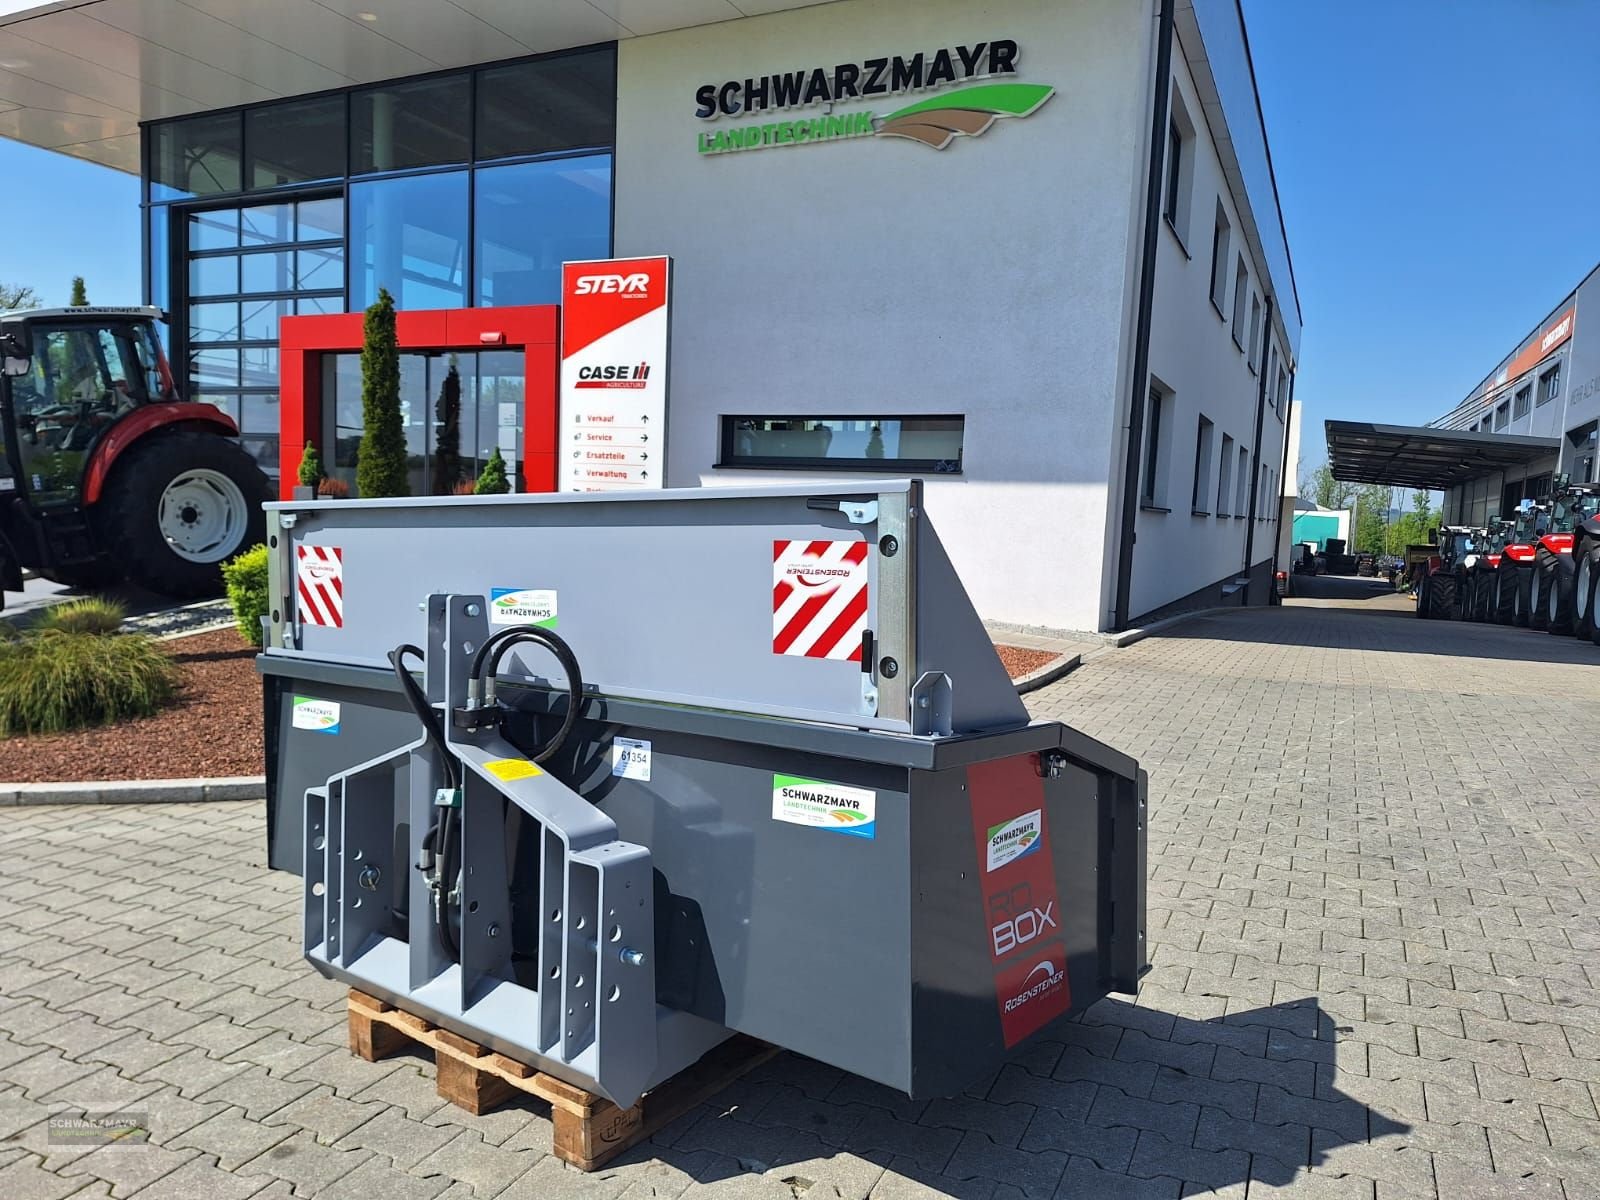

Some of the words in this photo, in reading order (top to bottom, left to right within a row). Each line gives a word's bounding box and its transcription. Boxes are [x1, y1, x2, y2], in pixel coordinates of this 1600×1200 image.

[695, 39, 1018, 118] SCHWARZMAYR
[698, 110, 876, 153] LANDTECHNIK
[574, 273, 649, 295] STEYR
[579, 366, 629, 380] CASE
[587, 415, 614, 423] Verkauf
[586, 451, 625, 460] Ersatzteile
[586, 469, 627, 479] Verwaltung
[786, 568, 850, 577] ROSENSTEINER
[500, 608, 551, 617] SCHWARZMAYR
[782, 787, 860, 810] SCHWARZMAYR
[783, 800, 827, 814] LANDTECHNIK
[992, 822, 1034, 847] SCHWARZMAYR
[992, 901, 1057, 957] BOX
[1004, 970, 1064, 1014] ROSENSTEINER
